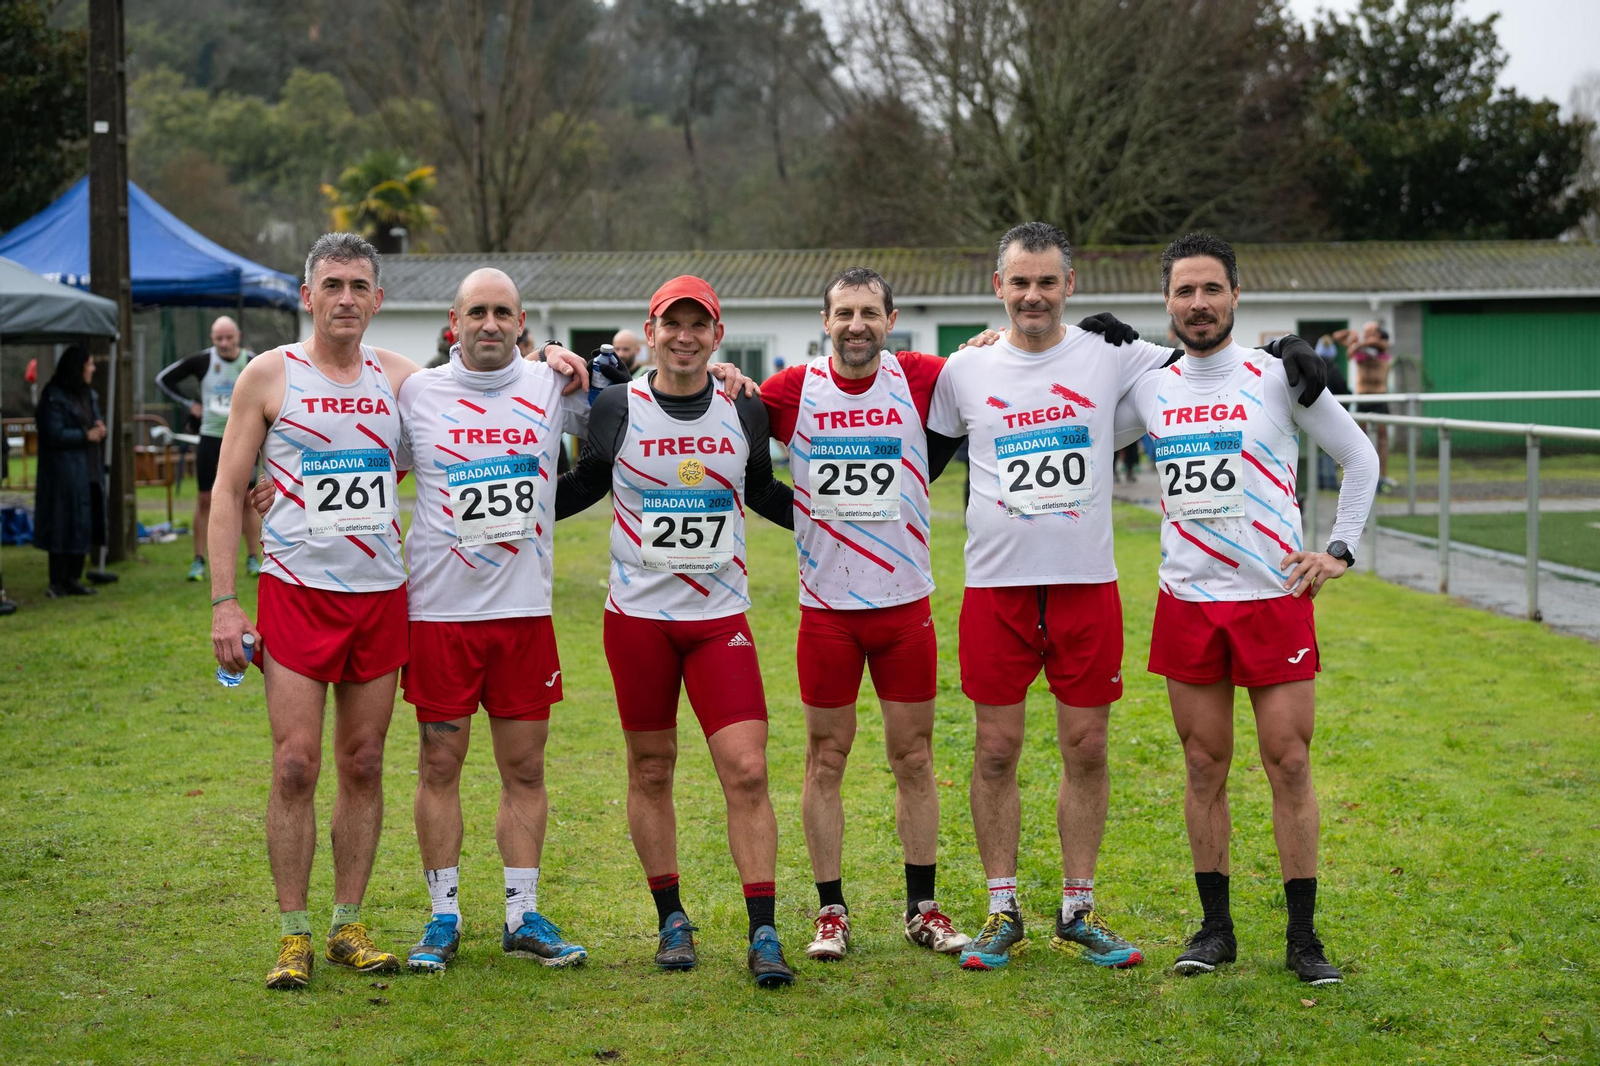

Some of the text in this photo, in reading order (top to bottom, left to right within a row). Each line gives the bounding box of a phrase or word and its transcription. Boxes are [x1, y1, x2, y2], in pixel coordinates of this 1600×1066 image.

[301, 398, 390, 415] TREGA
[1003, 404, 1077, 428] TREGA
[1163, 404, 1248, 426] TREGA
[813, 408, 903, 430] TREGA
[448, 428, 538, 445] TREGA
[639, 436, 736, 457] TREGA
[998, 434, 1087, 455] RIBADAVIA 2026
[811, 445, 899, 455] RIBADAVIA 2026
[1156, 440, 1239, 457] RIBADAVIA 2026
[303, 457, 389, 472] RIBADAVIA 2026
[449, 462, 537, 483] RIBADAVIA 2026
[1007, 452, 1085, 492] 260
[818, 463, 895, 496] 259
[1165, 458, 1236, 496] 256
[317, 476, 386, 512] 261
[459, 480, 534, 521] 258
[643, 497, 732, 508] RIBADAVIA 2026
[845, 510, 881, 518] atletismo.gal
[1041, 501, 1076, 510] atletismo.gal
[1187, 507, 1222, 516] atletismo.gal
[346, 523, 380, 532] atletismo.gal
[652, 515, 726, 549] 257
